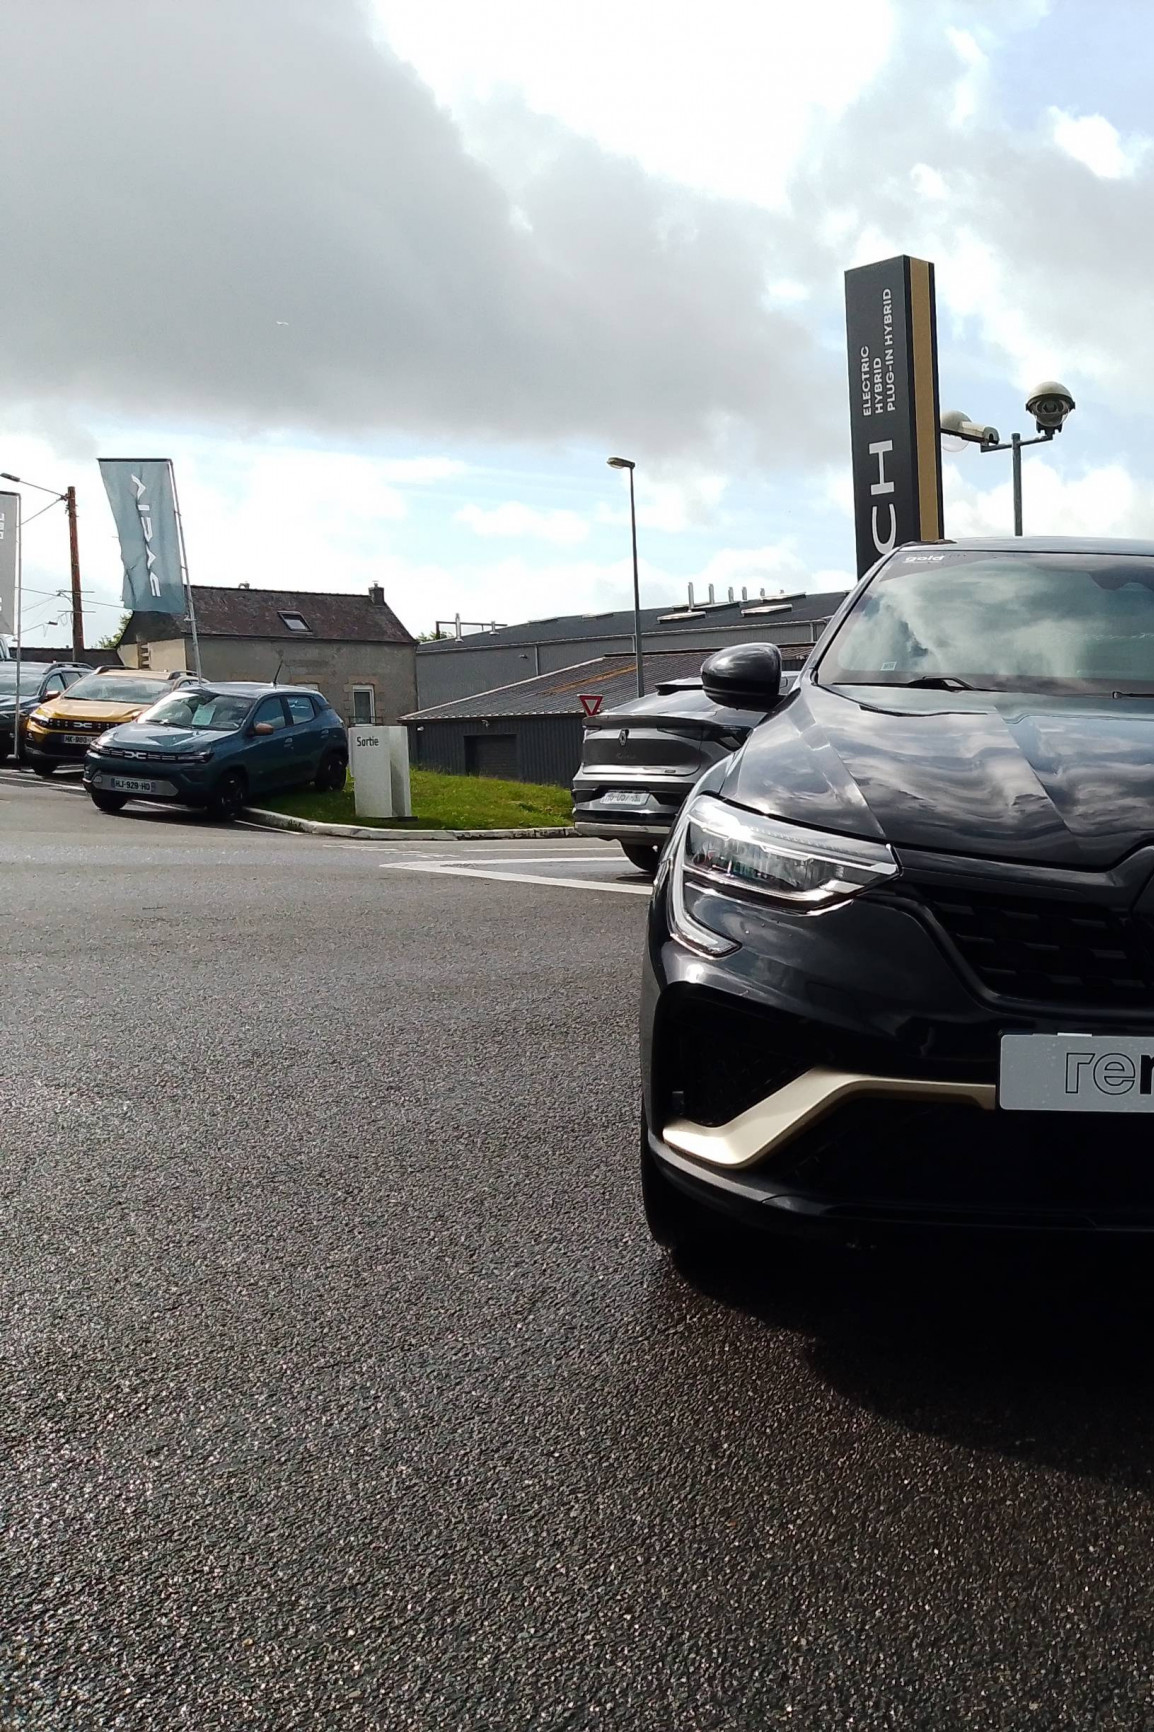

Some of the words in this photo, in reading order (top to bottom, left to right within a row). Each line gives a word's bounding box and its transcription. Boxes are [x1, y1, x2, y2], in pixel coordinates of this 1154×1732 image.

[882, 288, 893, 346] HYBRID
[860, 345, 871, 416] ELECTRIC
[873, 357, 883, 414] HYBRID
[885, 349, 895, 412] PLUG-IN
[356, 736, 379, 747] Sortie
